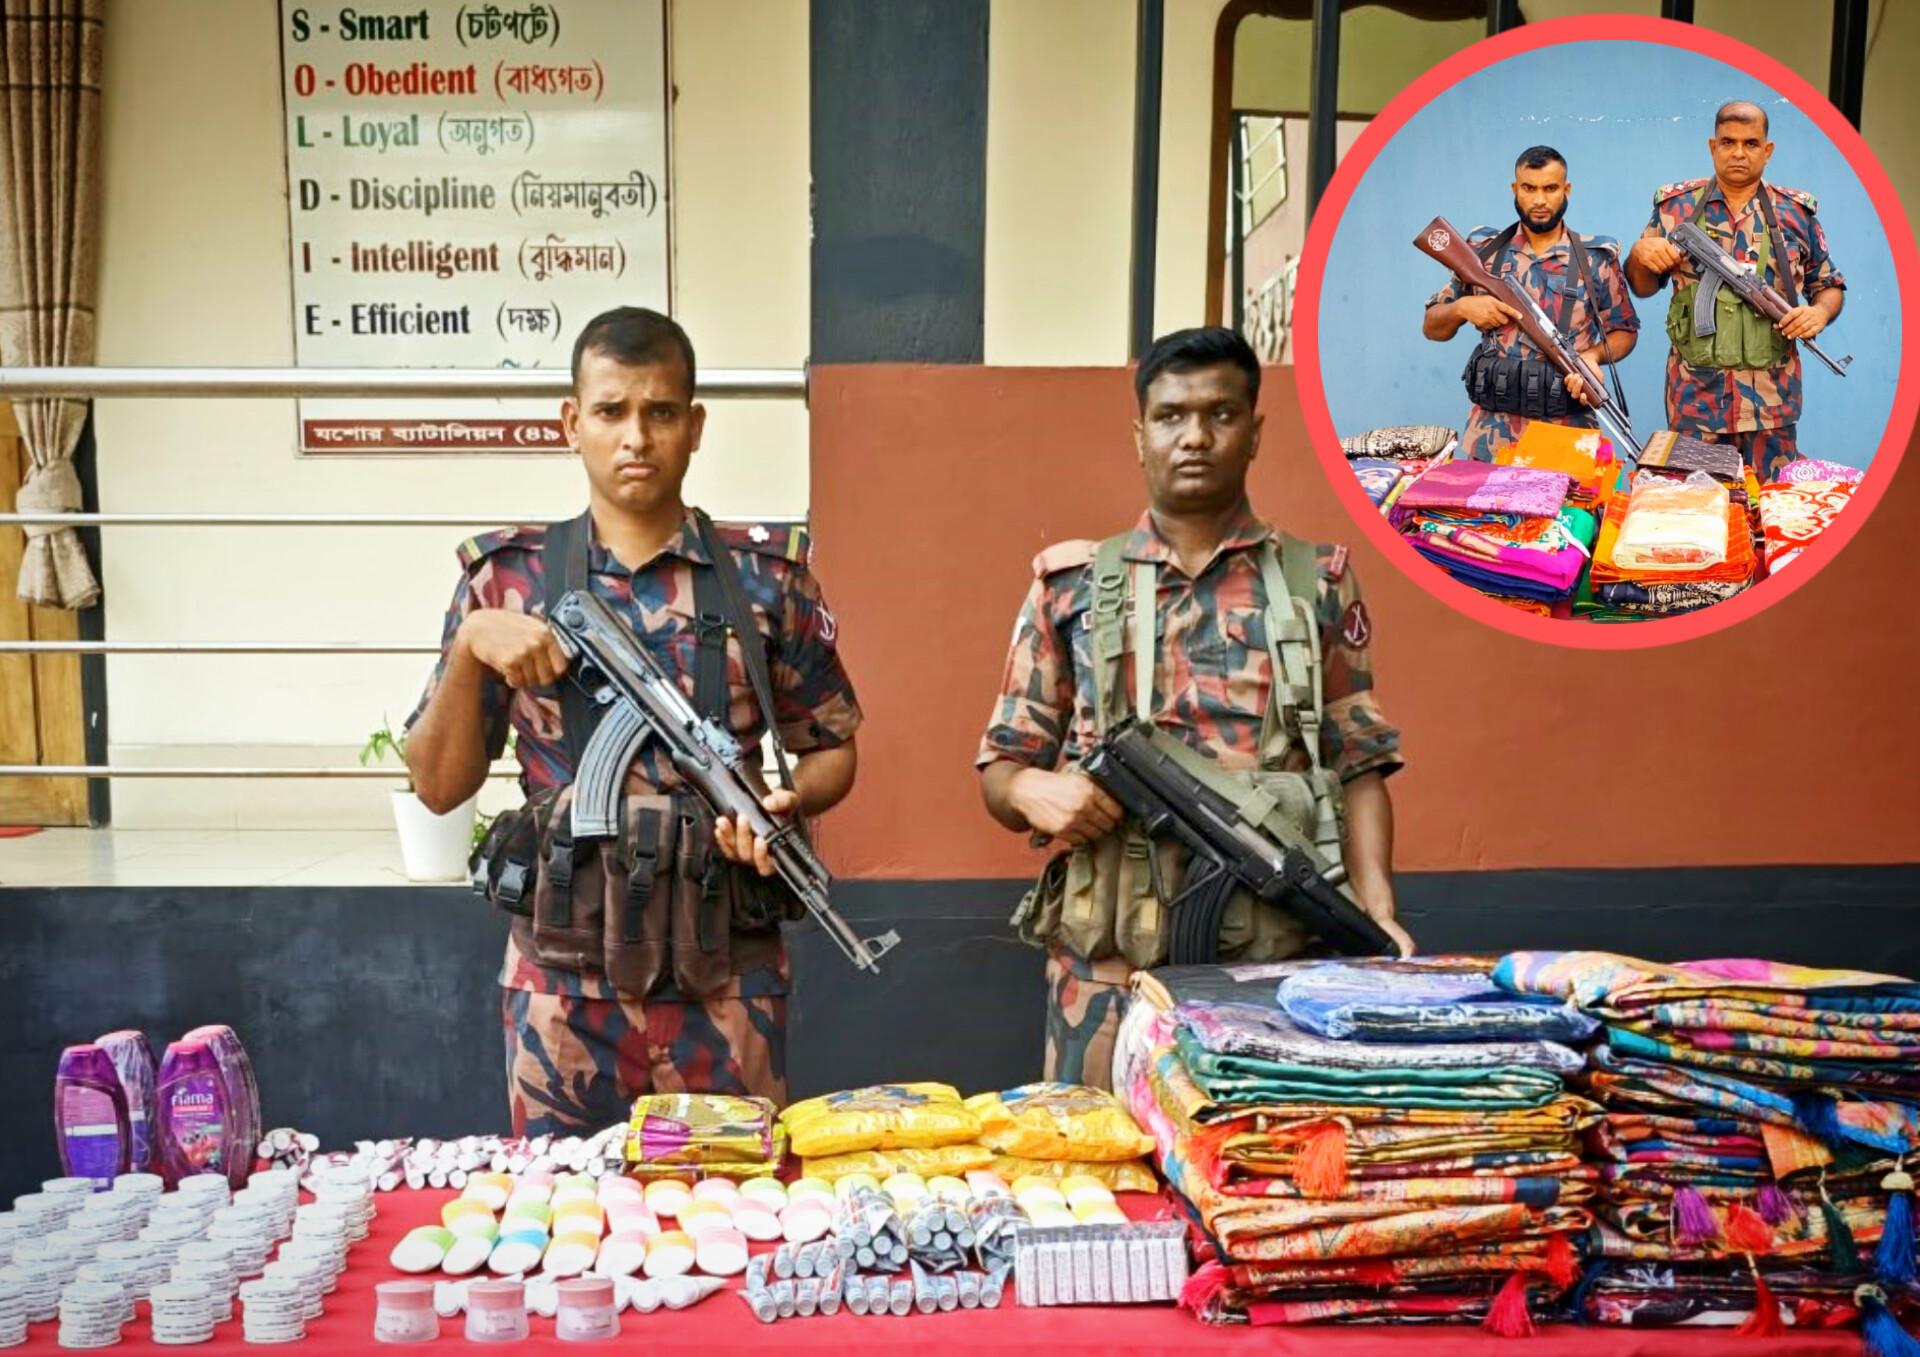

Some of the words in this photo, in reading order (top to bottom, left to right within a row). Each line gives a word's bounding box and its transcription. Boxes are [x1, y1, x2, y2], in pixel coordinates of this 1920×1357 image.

[292, 9, 310, 42] S
[340, 9, 429, 41] Smart
[456, 3, 560, 46] (চটপটে)
[294, 64, 315, 96] O
[345, 62, 477, 96] Obedient
[495, 58, 604, 101] (বাধ্যগত)
[296, 115, 314, 147] L
[343, 114, 419, 154] Loyal
[437, 111, 535, 155] (অনুগত)
[300, 179, 320, 211] D
[350, 177, 496, 216] Discipline
[303, 242, 311, 273] I
[351, 240, 499, 279] Intelligent
[518, 233, 626, 282] (বুদ্ধিমান)
[306, 304, 323, 335] E
[351, 303, 470, 335] Efficient
[496, 300, 562, 342] (দক্ষ)
[313, 426, 383, 442] যশোর
[391, 423, 506, 442] ব্যাটালিয়ন
